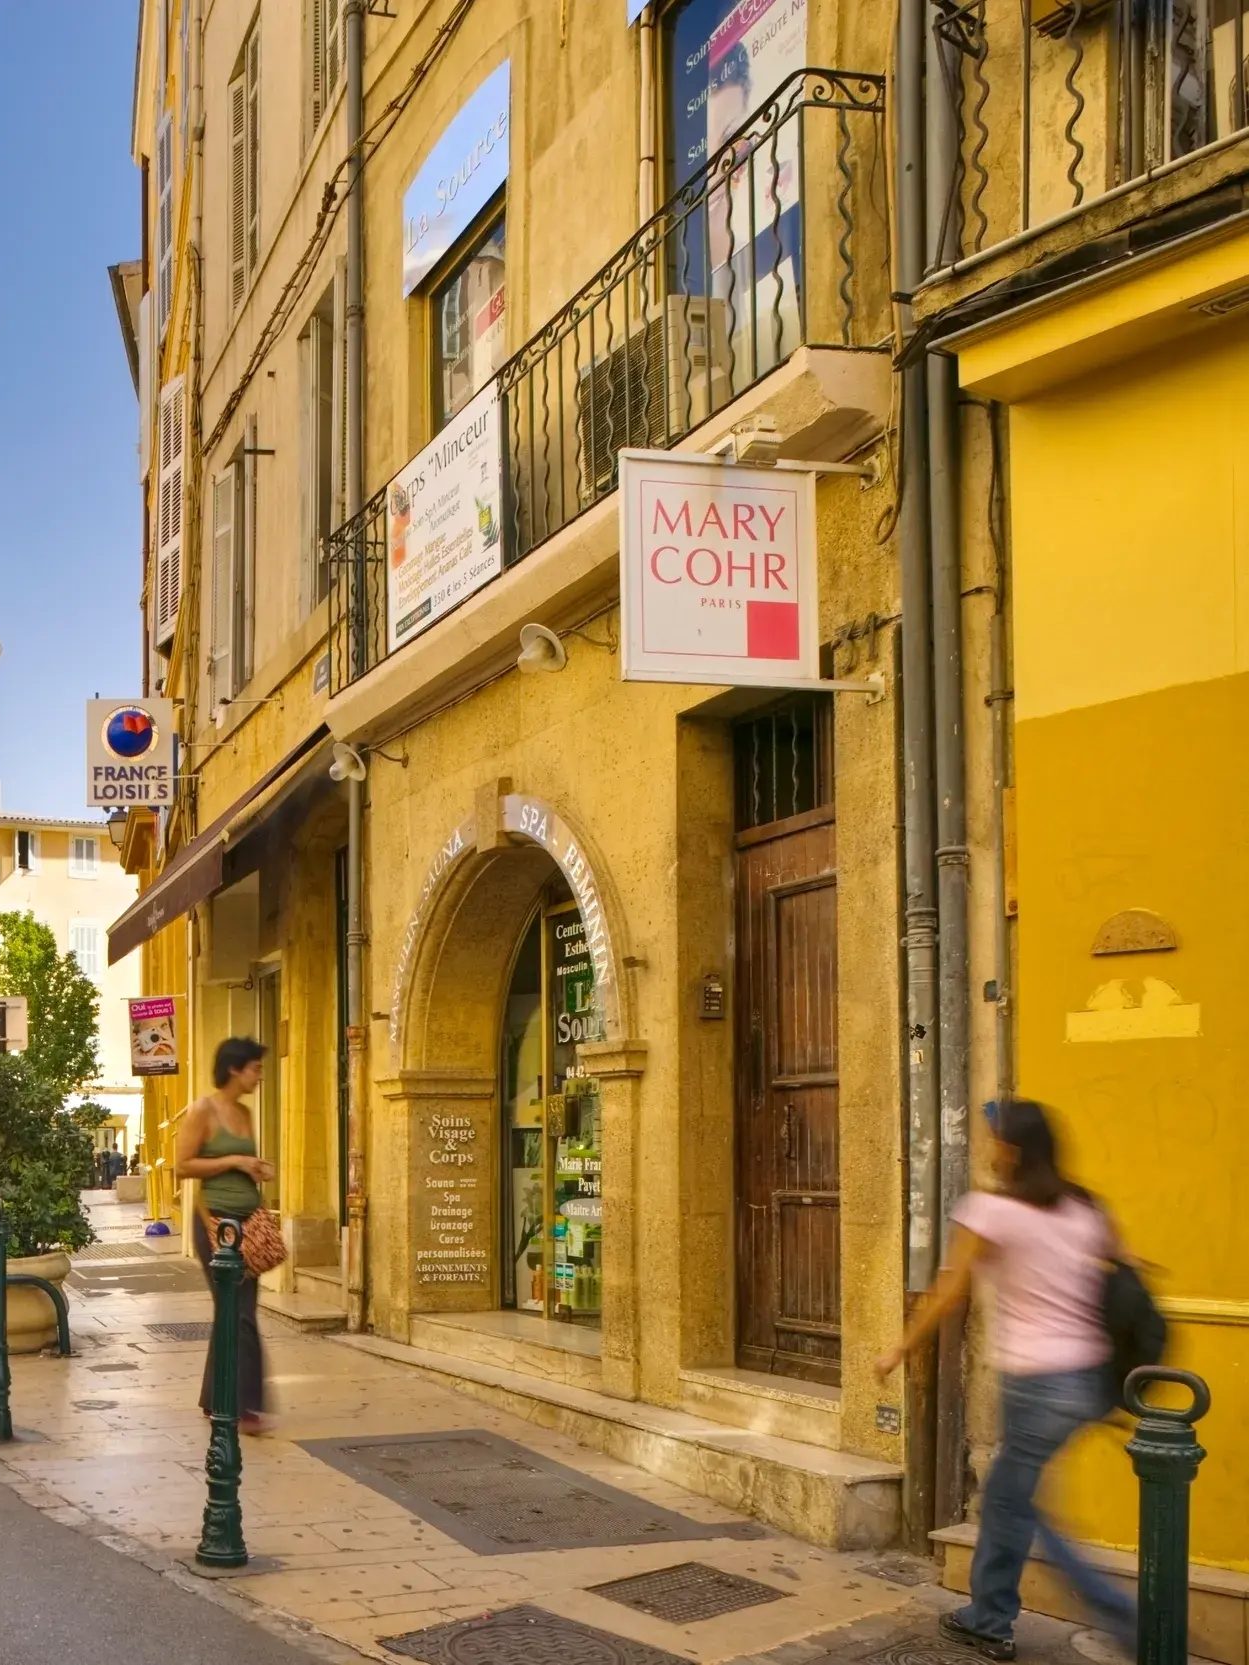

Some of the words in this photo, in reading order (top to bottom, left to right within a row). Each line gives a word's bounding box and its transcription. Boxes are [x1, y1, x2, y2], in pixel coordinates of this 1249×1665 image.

[686, 34, 718, 74] Soins
[687, 78, 719, 118] Soins
[720, 60, 735, 82] de
[407, 211, 430, 254] La
[436, 110, 508, 217] Source
[653, 498, 785, 541] MARY
[650, 546, 788, 591] COHR
[701, 598, 742, 610] PARIS
[93, 765, 167, 781] FRANCE
[423, 829, 464, 900] SAUNA
[520, 804, 547, 841] SPA
[562, 842, 611, 986] FEMININ
[556, 922, 585, 940] Centre
[556, 961, 588, 976] Masculin
[432, 1114, 471, 1127] Soins
[428, 1127, 476, 1142] Visage
[445, 1138, 458, 1151] &
[429, 1150, 473, 1166] Corps
[559, 1157, 583, 1170] Marie
[426, 1177, 454, 1188] Sauna
[578, 1177, 600, 1195] Payet
[443, 1191, 461, 1205] Spa
[431, 1205, 473, 1219] Drainage
[430, 1219, 473, 1233] Bronzage
[439, 1233, 465, 1244] Cures
[417, 1246, 486, 1261] personnalisées
[415, 1263, 488, 1272] ABONNEMENTS
[422, 1274, 430, 1282] &
[433, 1273, 481, 1282] FORFAITS
